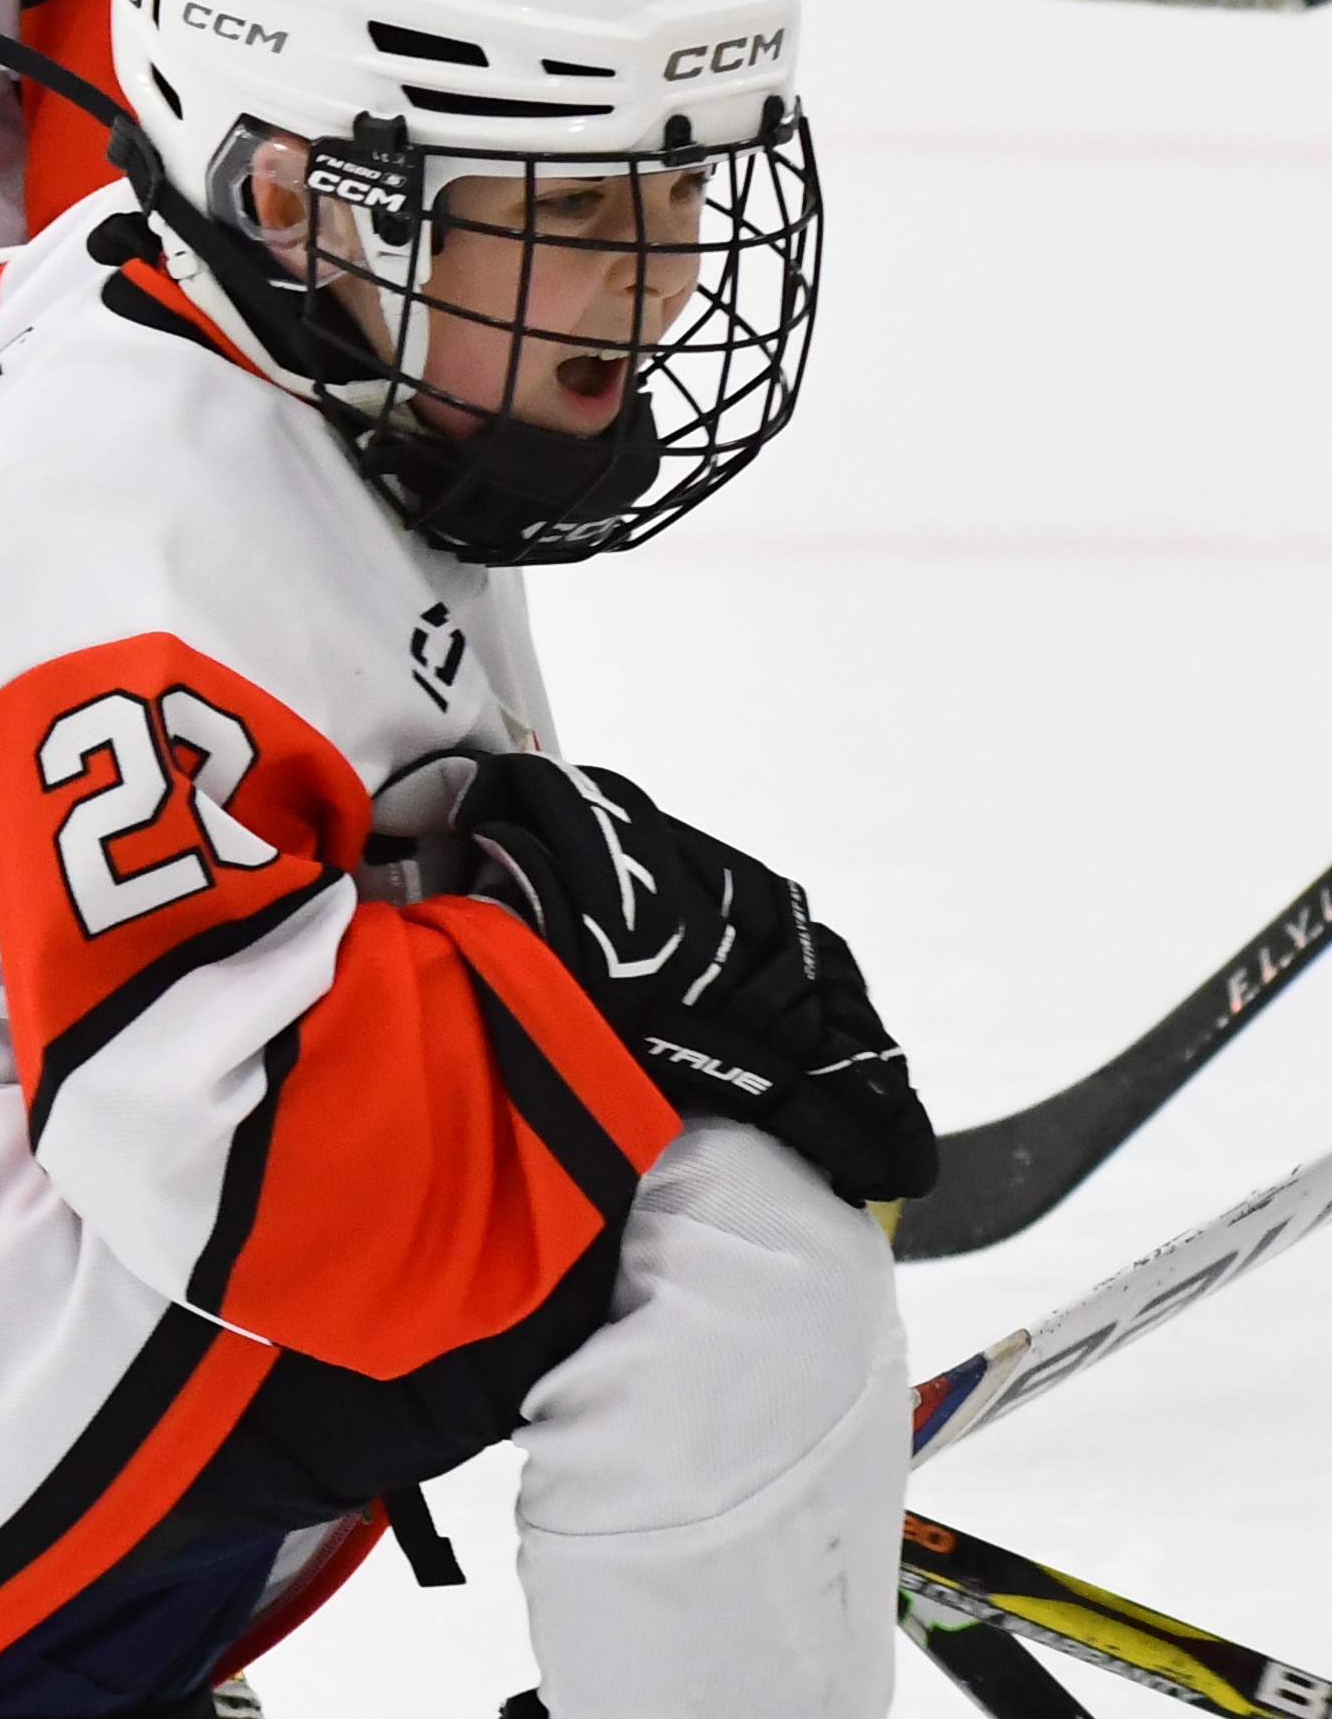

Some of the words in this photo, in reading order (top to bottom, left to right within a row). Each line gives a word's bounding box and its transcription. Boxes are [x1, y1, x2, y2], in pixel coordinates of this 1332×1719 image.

[182, 2, 290, 55] CCM
[663, 28, 785, 82] CCM
[307, 170, 407, 213] CCM
[643, 1036, 775, 1096] TRUE
[1255, 1661, 1332, 1719] B
